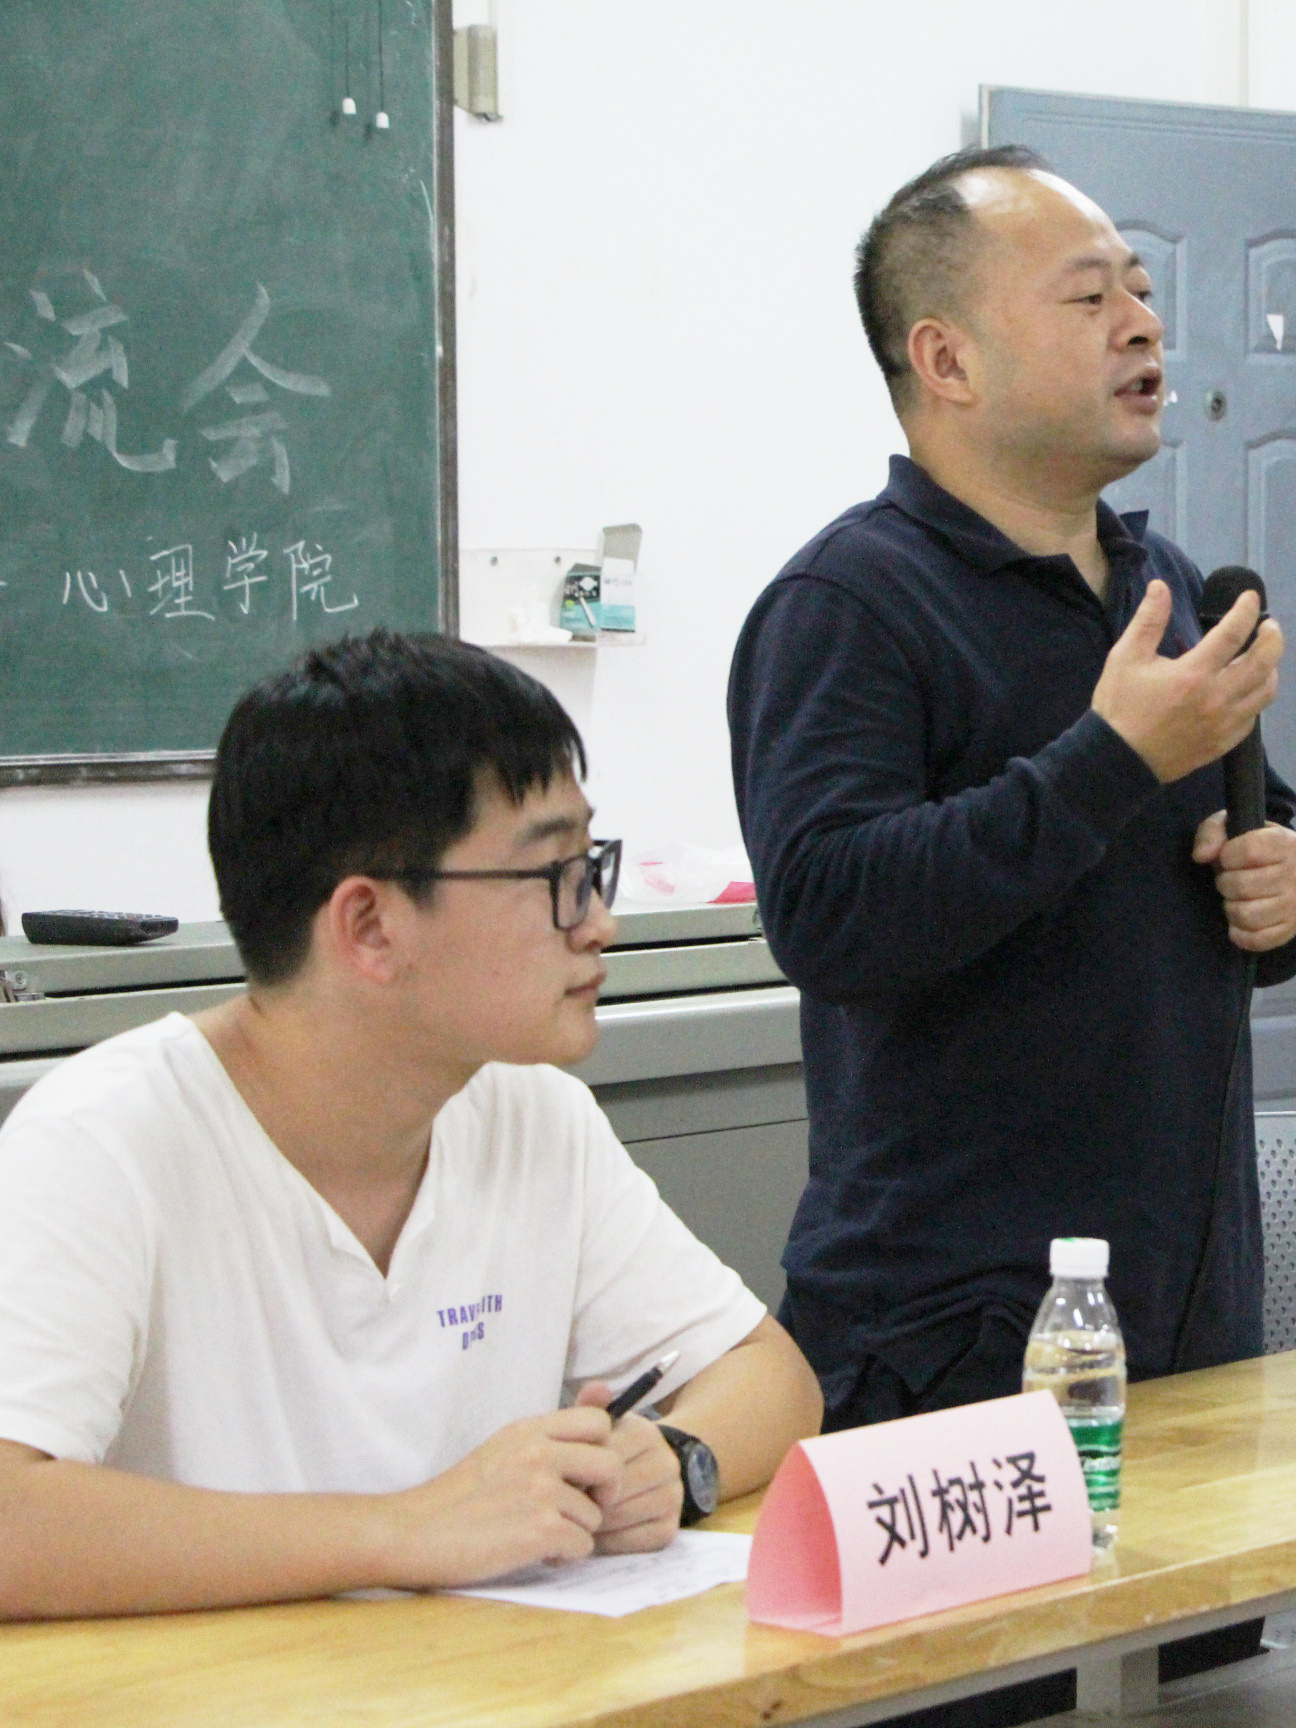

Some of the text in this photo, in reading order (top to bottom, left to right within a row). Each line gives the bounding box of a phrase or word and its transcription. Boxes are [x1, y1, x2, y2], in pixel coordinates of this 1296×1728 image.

[63, 532, 358, 622] 心理学院
[867, 1450, 1053, 1567] 刘树泽
